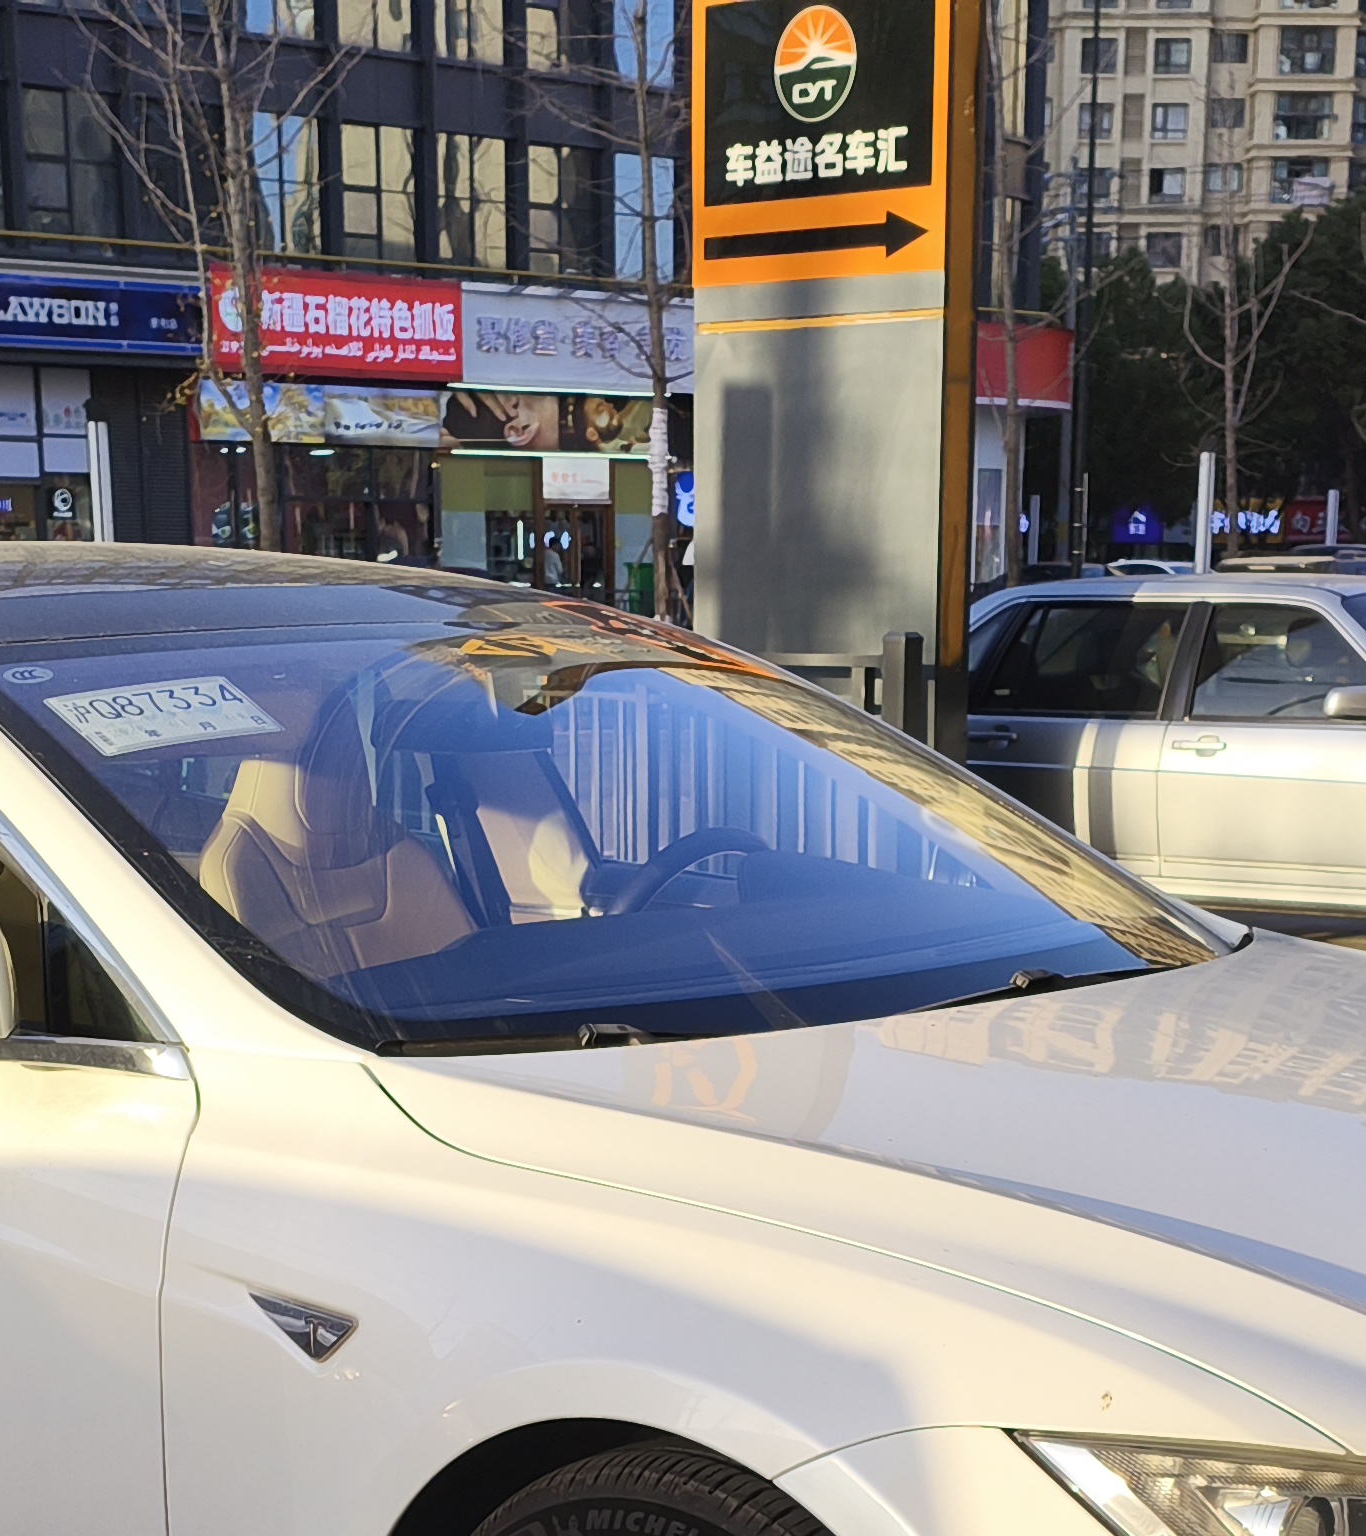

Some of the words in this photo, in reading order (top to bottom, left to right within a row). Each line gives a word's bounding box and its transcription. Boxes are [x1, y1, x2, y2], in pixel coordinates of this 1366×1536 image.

[725, 126, 909, 187] 车益途名车汇
[260, 289, 456, 342] 新疆石榴花特色抓饭
[63, 684, 244, 724] 沪Q87334
